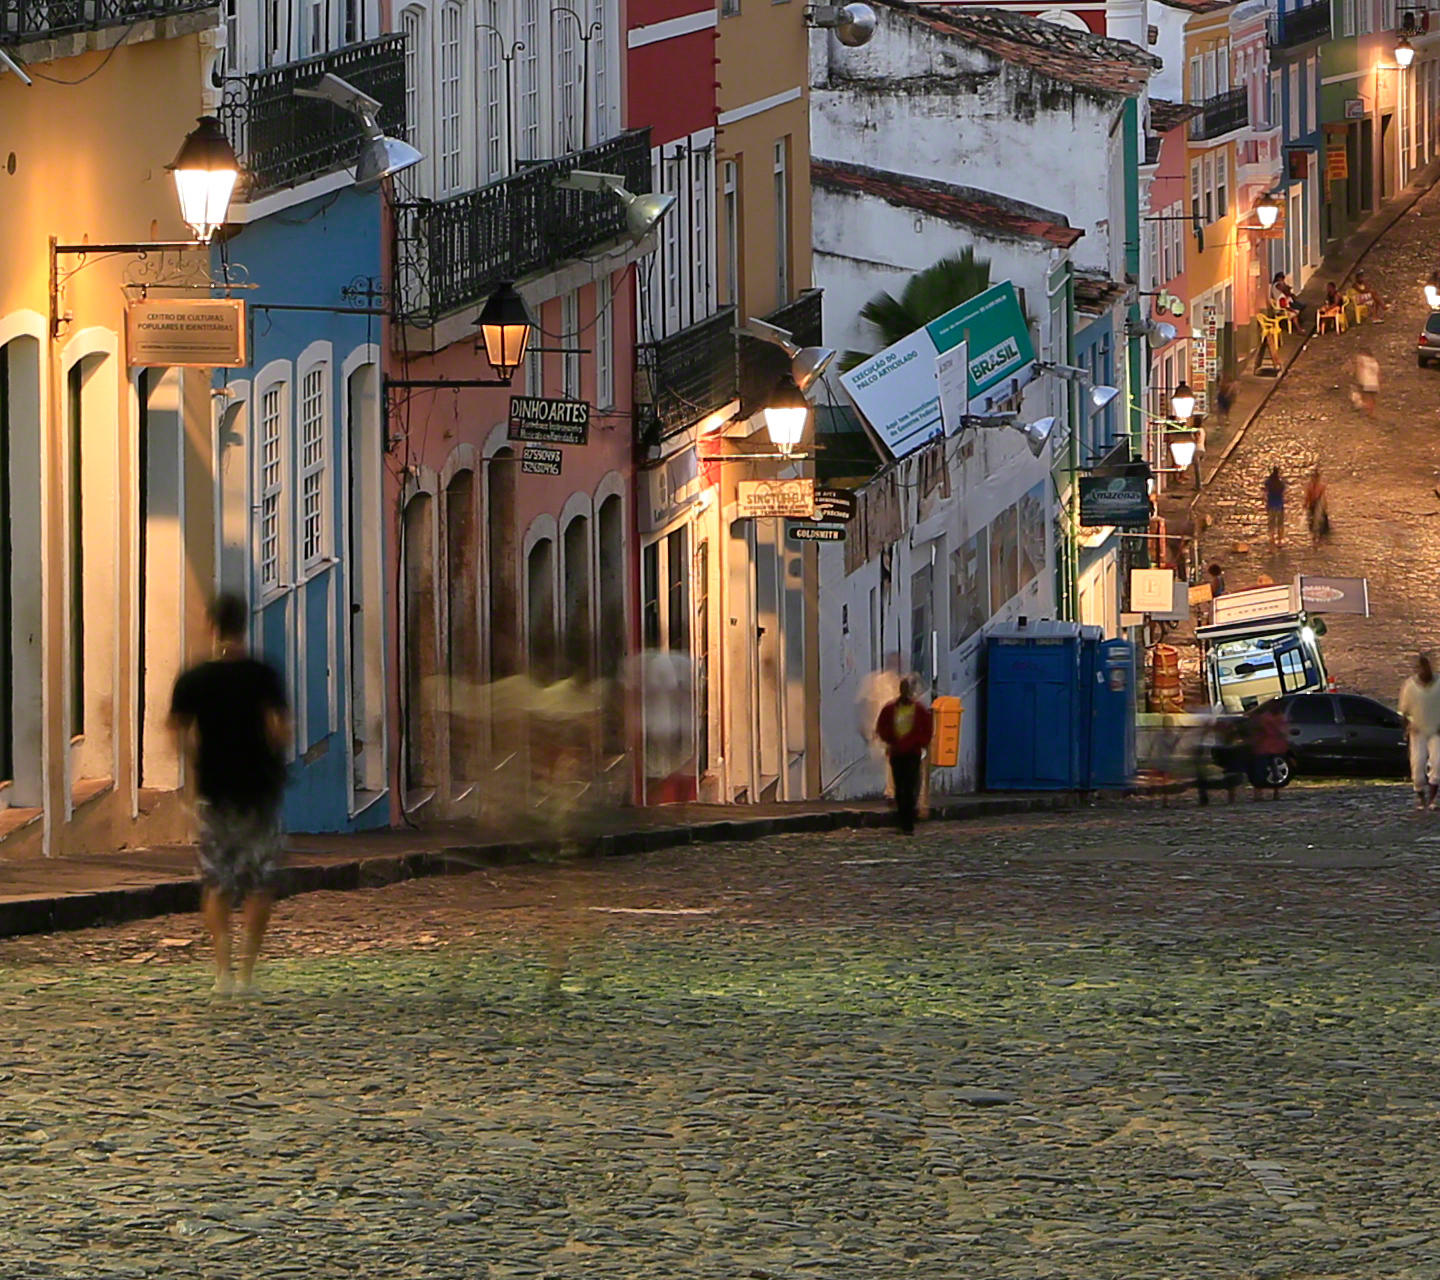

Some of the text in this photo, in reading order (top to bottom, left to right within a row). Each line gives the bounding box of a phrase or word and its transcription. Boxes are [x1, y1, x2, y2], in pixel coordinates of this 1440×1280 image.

[137, 323, 179, 331] POPULARES
[147, 313, 225, 322] CENTRO DE CULTURAS
[851, 352, 897, 384] EXECUÇÃO DO
[856, 374, 879, 391] PALCO
[878, 350, 919, 378] ARTICULADO
[970, 343, 1019, 381] BRASIL
[511, 399, 587, 423] DINHO ARTES
[1090, 487, 1142, 502] Amazonas
[796, 529, 839, 539] GOLDSMITH
